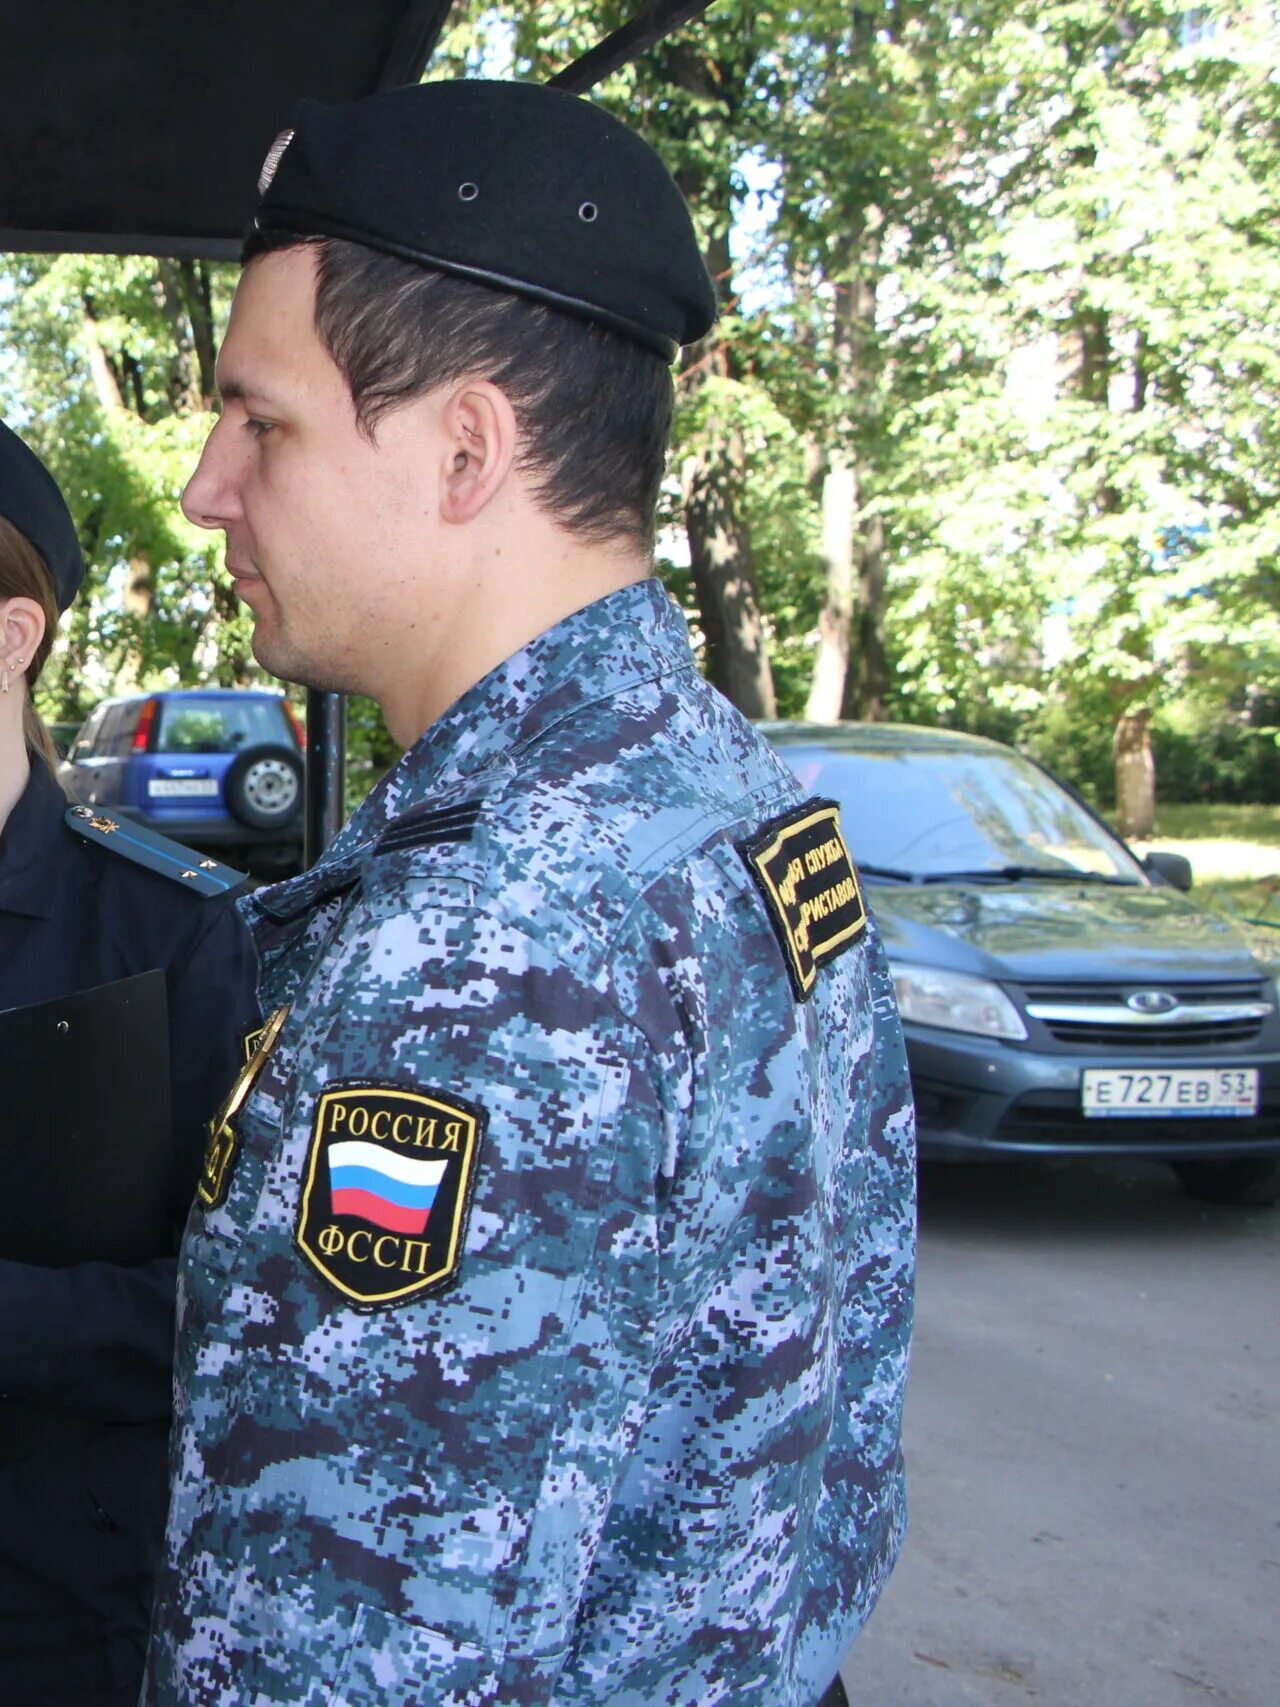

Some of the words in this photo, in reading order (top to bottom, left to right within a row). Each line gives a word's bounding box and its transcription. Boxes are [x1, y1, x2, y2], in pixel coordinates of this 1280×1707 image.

[1220, 1072, 1246, 1095] 53
[330, 1103, 462, 1153] РОССИЯ
[318, 1224, 431, 1275] ФССП
